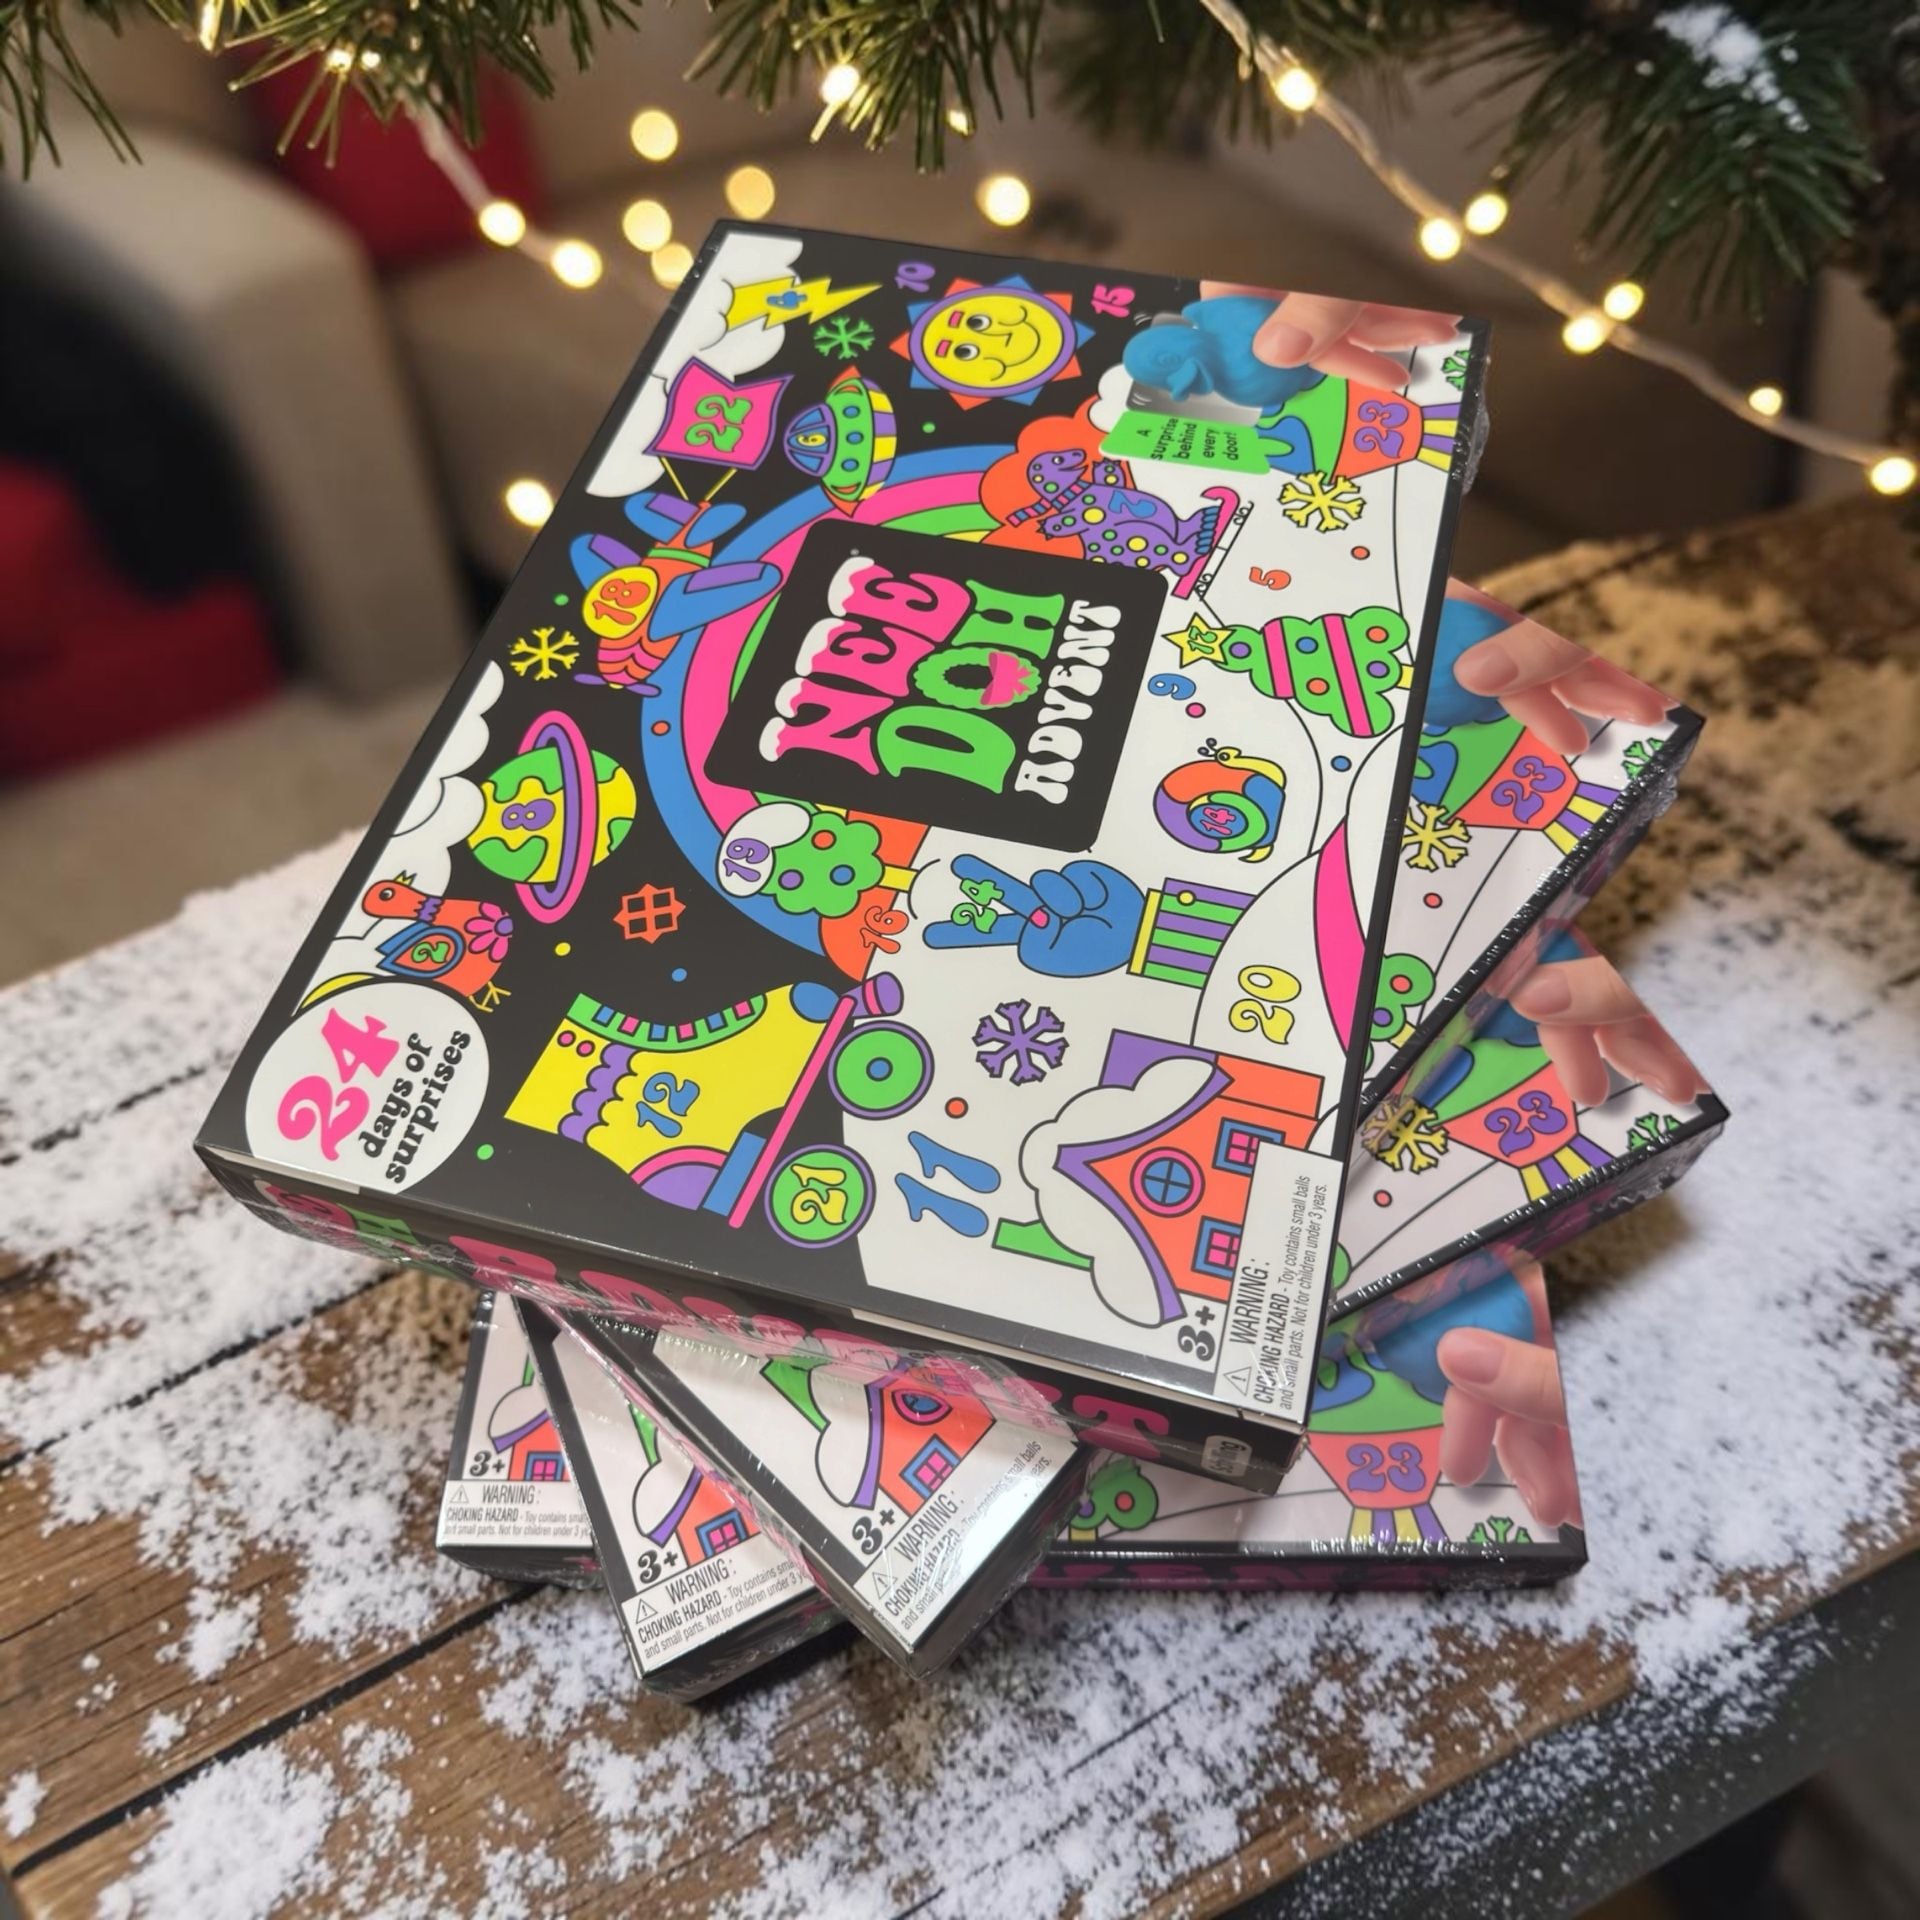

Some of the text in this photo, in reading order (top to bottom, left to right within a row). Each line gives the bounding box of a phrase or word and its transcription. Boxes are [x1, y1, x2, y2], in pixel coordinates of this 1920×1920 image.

[895, 261, 936, 293] 10
[1091, 284, 1135, 318] 15
[684, 394, 753, 453] 22
[1136, 428, 1152, 437] A
[1150, 417, 1179, 460] surprise
[1172, 423, 1197, 460] behind
[1202, 428, 1220, 458] every
[1353, 400, 1409, 459] 23
[1221, 431, 1239, 460] door!
[1249, 567, 1292, 590] 5
[592, 578, 651, 626] 18
[759, 555, 973, 776] NEE
[876, 579, 1065, 795] DOH
[1014, 599, 1122, 804] ADVENT
[1148, 673, 1197, 700] 9
[1491, 755, 1566, 824] 23
[501, 798, 556, 831] 8
[1200, 807, 1237, 836] 14
[723, 837, 770, 883] 19
[950, 879, 1005, 934] 24
[860, 906, 910, 955] 16
[412, 940, 449, 963] 2
[1229, 965, 1301, 1045] 20
[277, 1007, 400, 1162] 24
[358, 1033, 433, 1158] days of
[385, 1030, 471, 1184] surprises
[637, 1071, 700, 1138] 12
[1485, 1090, 1567, 1155] 23
[791, 1163, 848, 1224] 21
[895, 1131, 1001, 1238] 11
[1293, 1175, 1311, 1198] balls
[1312, 1184, 1327, 1213] years.
[1291, 1197, 1306, 1225] small
[1308, 1211, 1323, 1220] 3
[1284, 1226, 1303, 1267] contains
[1304, 1220, 1321, 1249] under
[1278, 1267, 1298, 1285] Toy
[1297, 1249, 1317, 1290] children
[1290, 1306, 1308, 1326] Not
[1293, 1290, 1310, 1306] for
[1177, 1306, 1216, 1362] 3+
[1263, 1293, 1290, 1344] HAZARD
[1284, 1358, 1300, 1388] small
[1279, 1388, 1295, 1410] and
[469, 1450, 506, 1477] 3+
[1020, 1440, 1042, 1463] balls
[1346, 1442, 1427, 1492] 23
[446, 1506, 483, 1522] CHOKING
[485, 1506, 519, 1522] HAZARD
[538, 1512, 567, 1523] contains
[524, 1524, 552, 1536] children
[553, 1524, 573, 1536] under
[852, 1508, 895, 1556] 3+
[637, 1549, 678, 1584] 3+
[638, 1609, 683, 1644] CHOKING
[681, 1590, 722, 1622] HAZARD
[728, 1584, 743, 1599] Toy
[743, 1568, 777, 1591] contains
[644, 1641, 661, 1659] and
[660, 1630, 683, 1651] small
[706, 1609, 722, 1627] Not
[721, 1604, 734, 1620] for
[735, 1589, 767, 1613] children
[766, 1577, 790, 1596] under
[789, 1571, 797, 1585] 3
[901, 1608, 919, 1631] and
